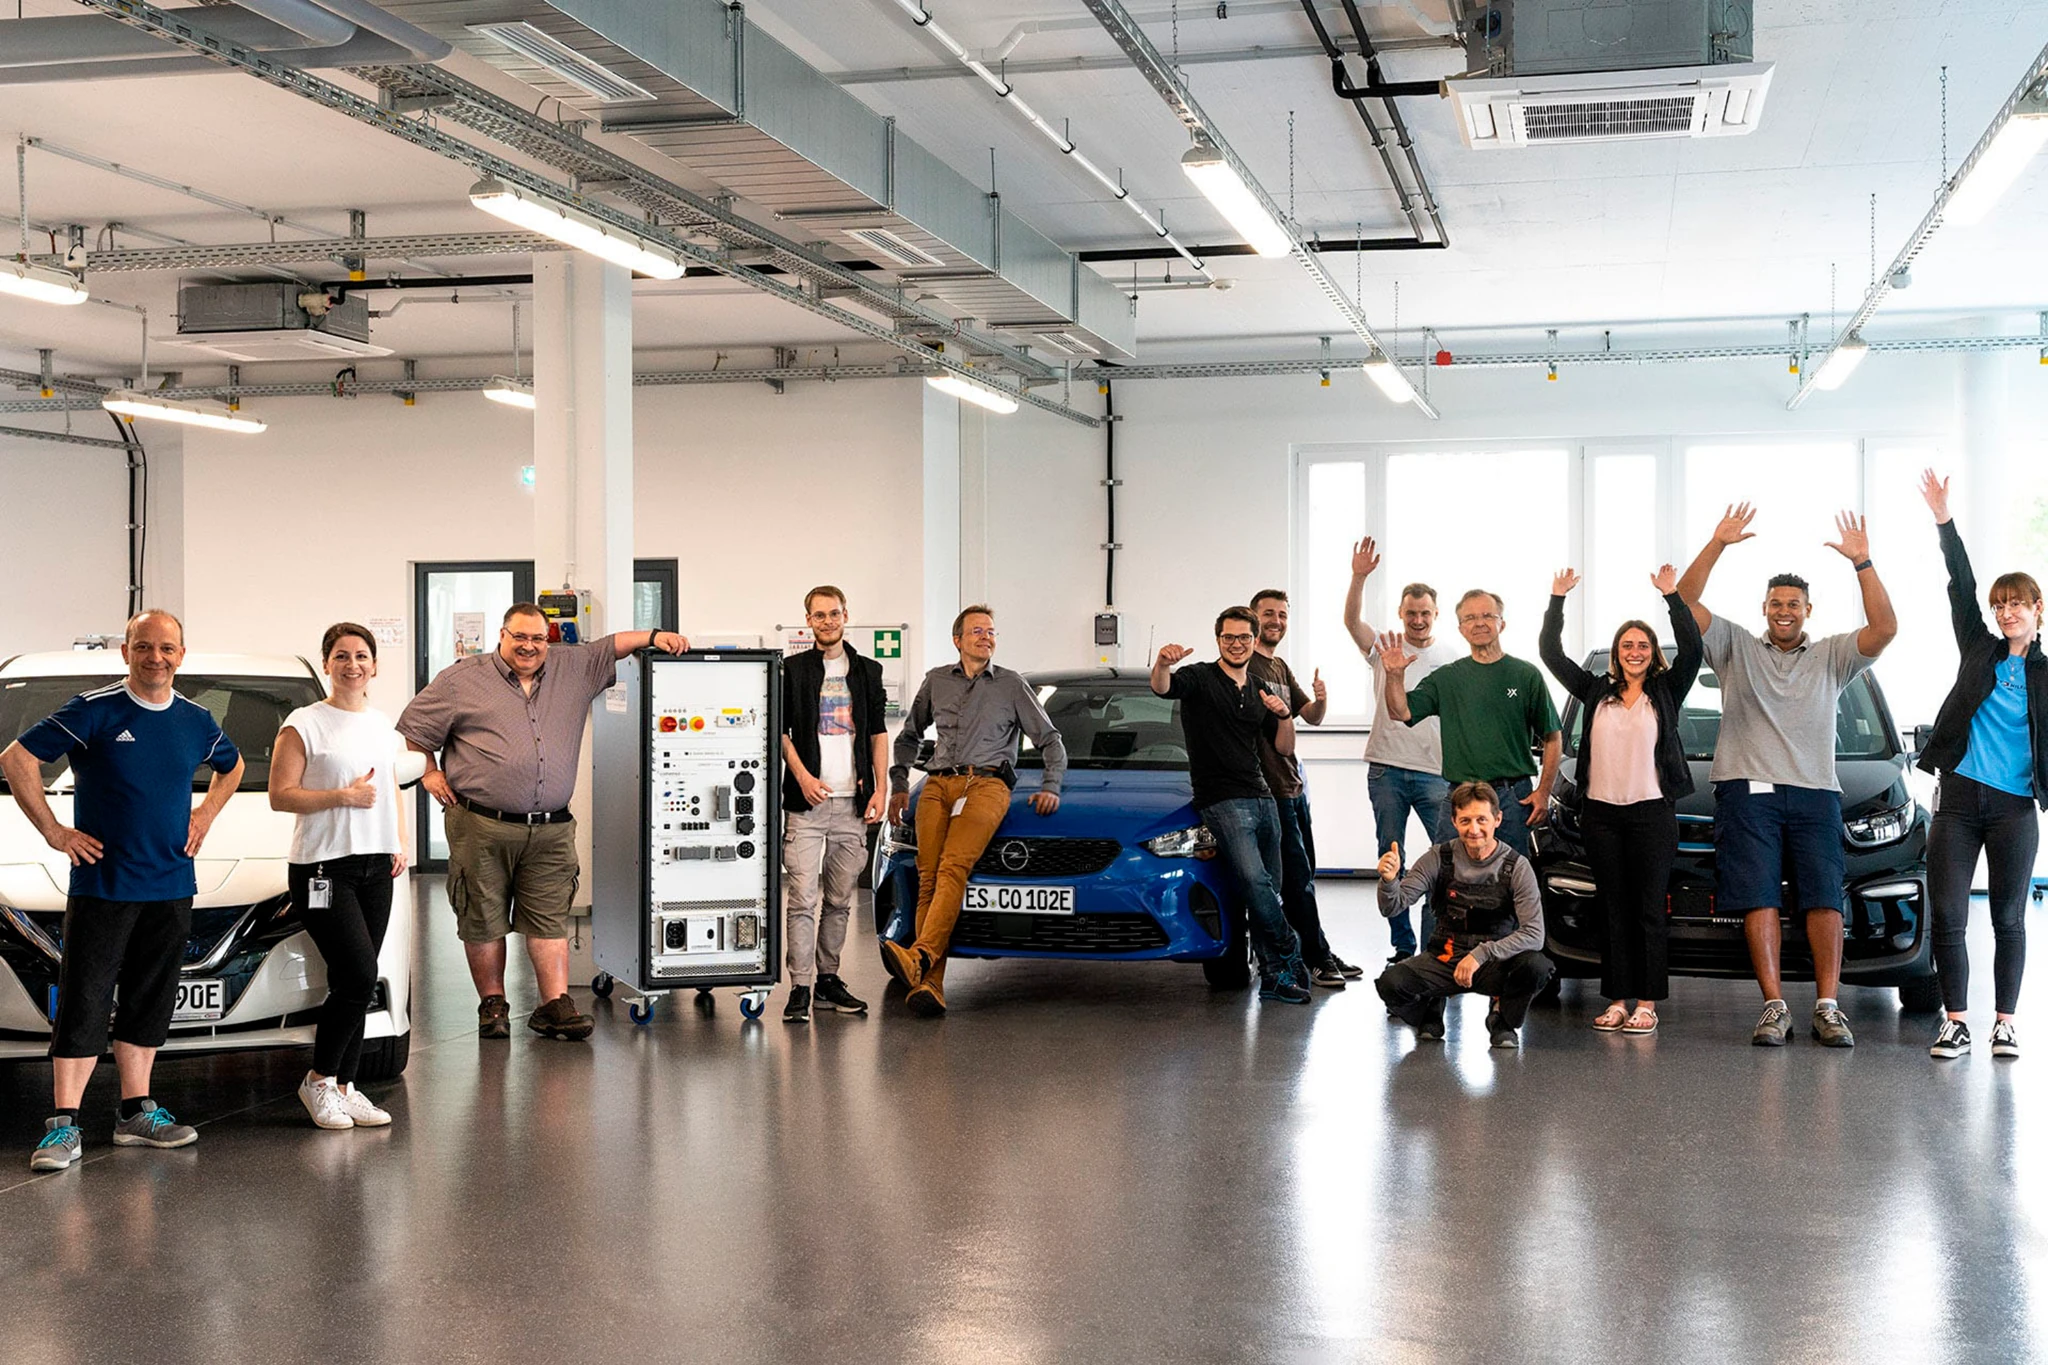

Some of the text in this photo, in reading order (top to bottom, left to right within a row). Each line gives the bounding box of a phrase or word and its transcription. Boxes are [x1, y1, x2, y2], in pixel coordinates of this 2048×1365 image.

[965, 887, 1071, 911] ES CO 102E
